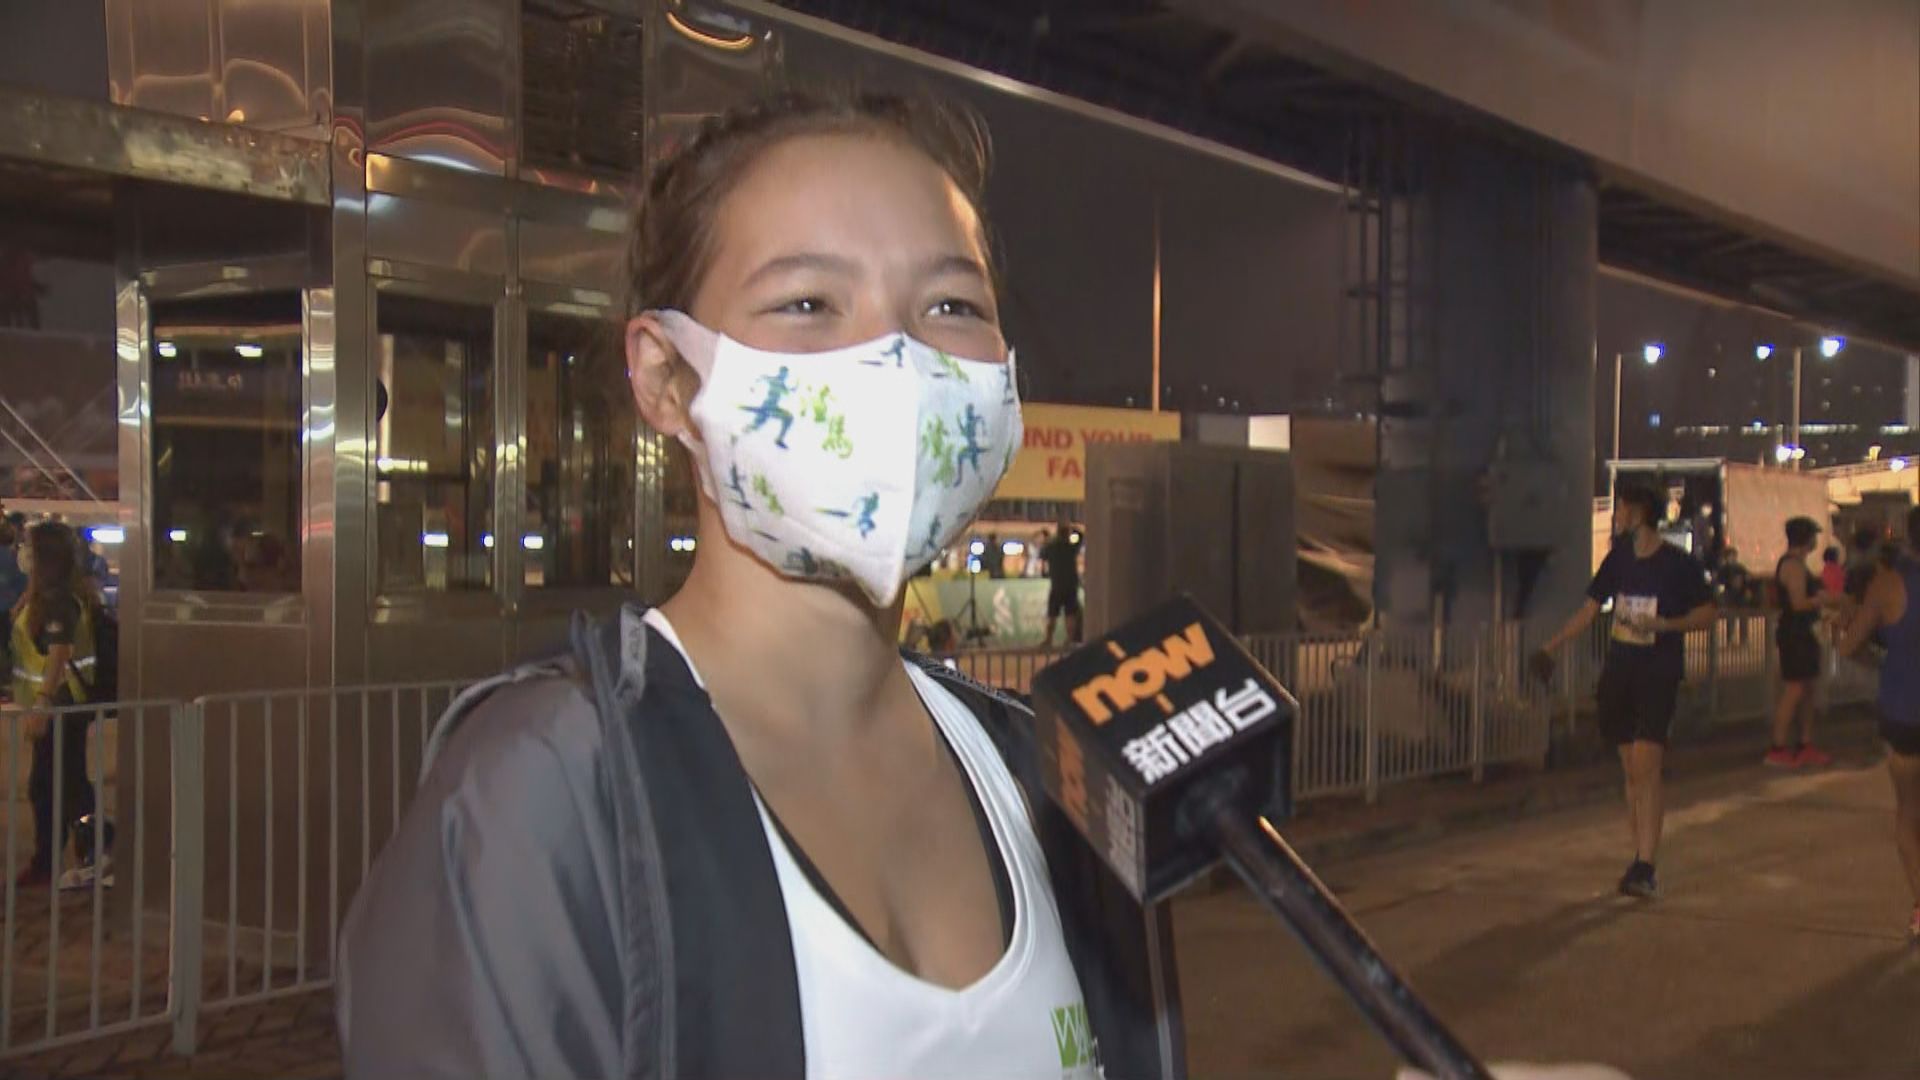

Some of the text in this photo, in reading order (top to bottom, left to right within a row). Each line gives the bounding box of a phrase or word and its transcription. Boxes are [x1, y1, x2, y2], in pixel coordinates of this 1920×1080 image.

[1024, 426, 1072, 448] IND
[1046, 457, 1081, 480] FA
[1072, 622, 1216, 727] now
[1121, 678, 1277, 785] 新聞台
